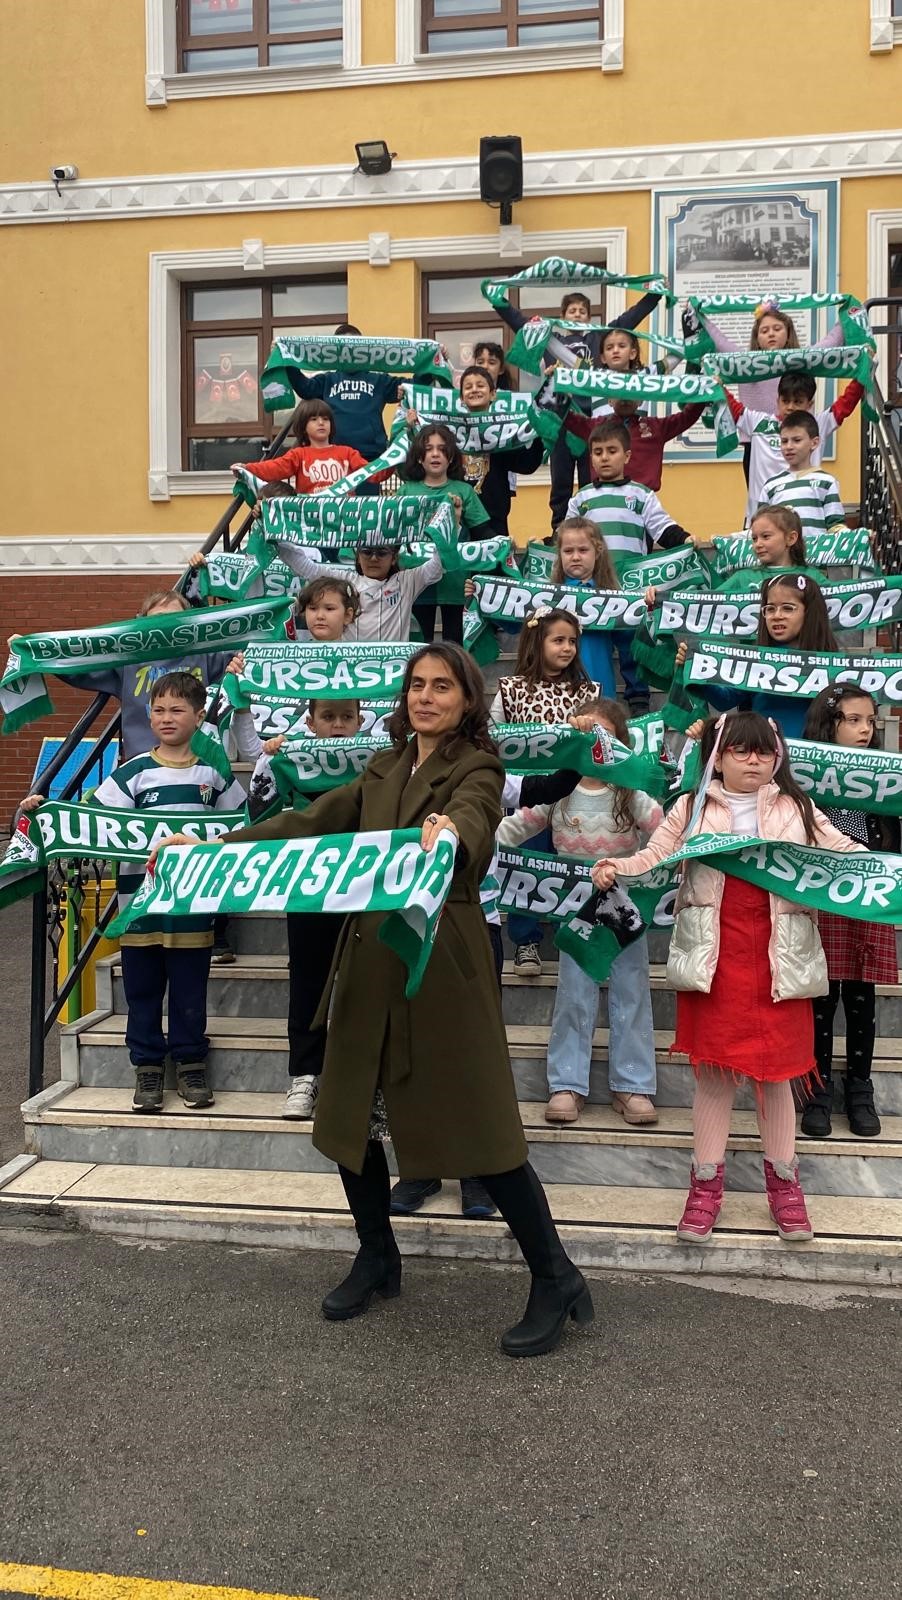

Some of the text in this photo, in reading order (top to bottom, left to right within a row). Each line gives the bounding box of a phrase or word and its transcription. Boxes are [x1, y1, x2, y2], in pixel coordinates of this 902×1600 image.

[703, 350, 861, 376] BURSASPOR
[329, 379, 375, 398] NATURE
[556, 368, 718, 395] BURSASPOR
[340, 392, 361, 401] SPIRIT
[673, 592, 728, 603] ÇOCUKLUK
[26, 610, 275, 662] BURSASPOR
[285, 644, 333, 658] İZİNDEYİZ
[336, 645, 393, 657] ARMAMIZIN
[702, 643, 762, 660] ÇOCUKLUK
[764, 652, 805, 666] AŞKIM,
[807, 656, 830, 666] SEN
[832, 654, 850, 667] İLK
[303, 737, 357, 747] ATAMIZIN
[825, 751, 890, 768] ARMAMIZIN
[157, 840, 453, 902] BURSASPOR
[527, 857, 571, 876] AŞKIM,
[822, 856, 884, 873] PEŞİNDEYİZ
[738, 842, 897, 908] ASPOR
